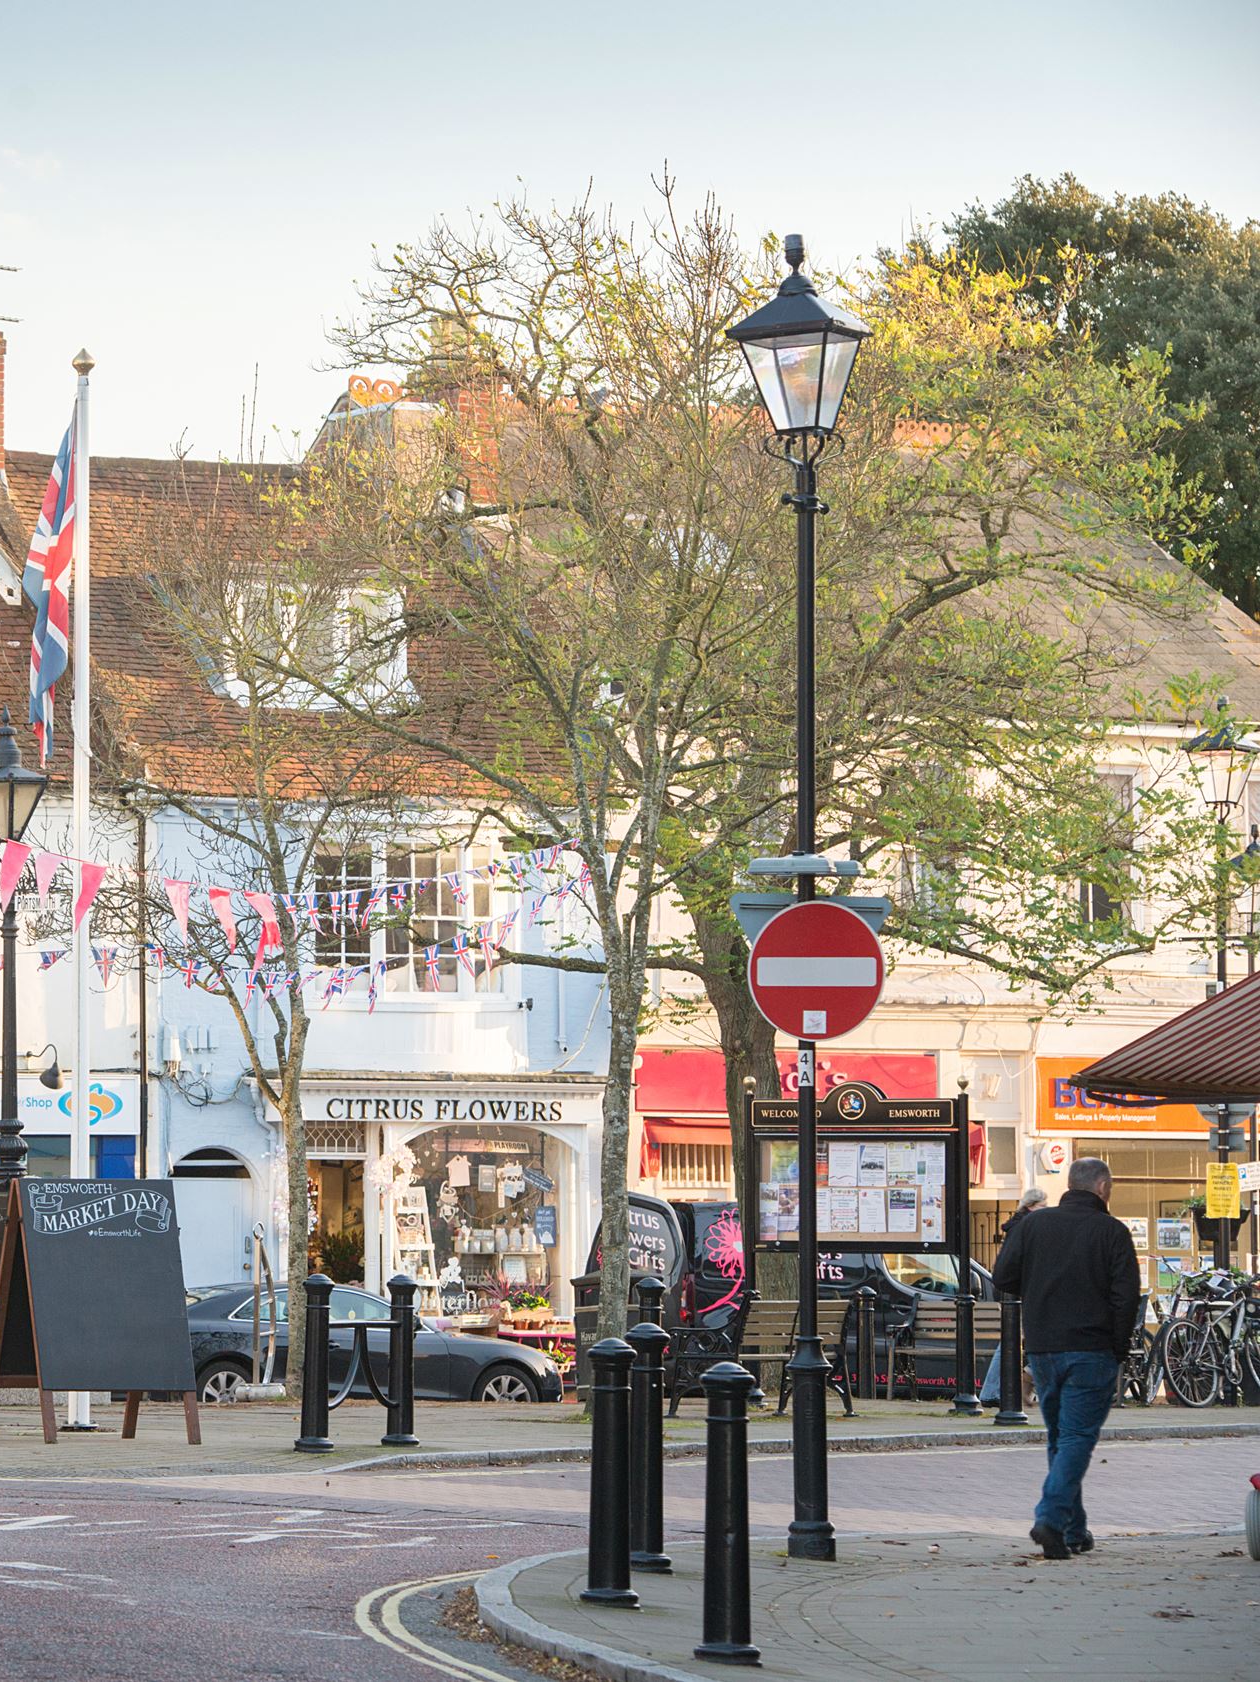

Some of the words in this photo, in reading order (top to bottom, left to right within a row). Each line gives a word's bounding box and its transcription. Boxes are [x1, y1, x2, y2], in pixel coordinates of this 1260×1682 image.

[800, 1052, 809, 1065] 4
[800, 1071, 811, 1084] A
[25, 1097, 53, 1109] Shop
[326, 1097, 424, 1120] CITRUS
[435, 1099, 563, 1121] FLOWERS
[761, 1109, 800, 1118] WELCOM
[889, 1109, 940, 1118] EMSWORTH
[493, 1140, 527, 1151] PLAYROOM
[44, 1183, 113, 1194] EMSWORTH
[43, 1196, 117, 1232] MARKET
[122, 1191, 162, 1212] DAY
[628, 1210, 660, 1230] trus
[629, 1231, 666, 1251] wers
[628, 1247, 666, 1271] Gifts
[816, 1261, 844, 1280] ifts
